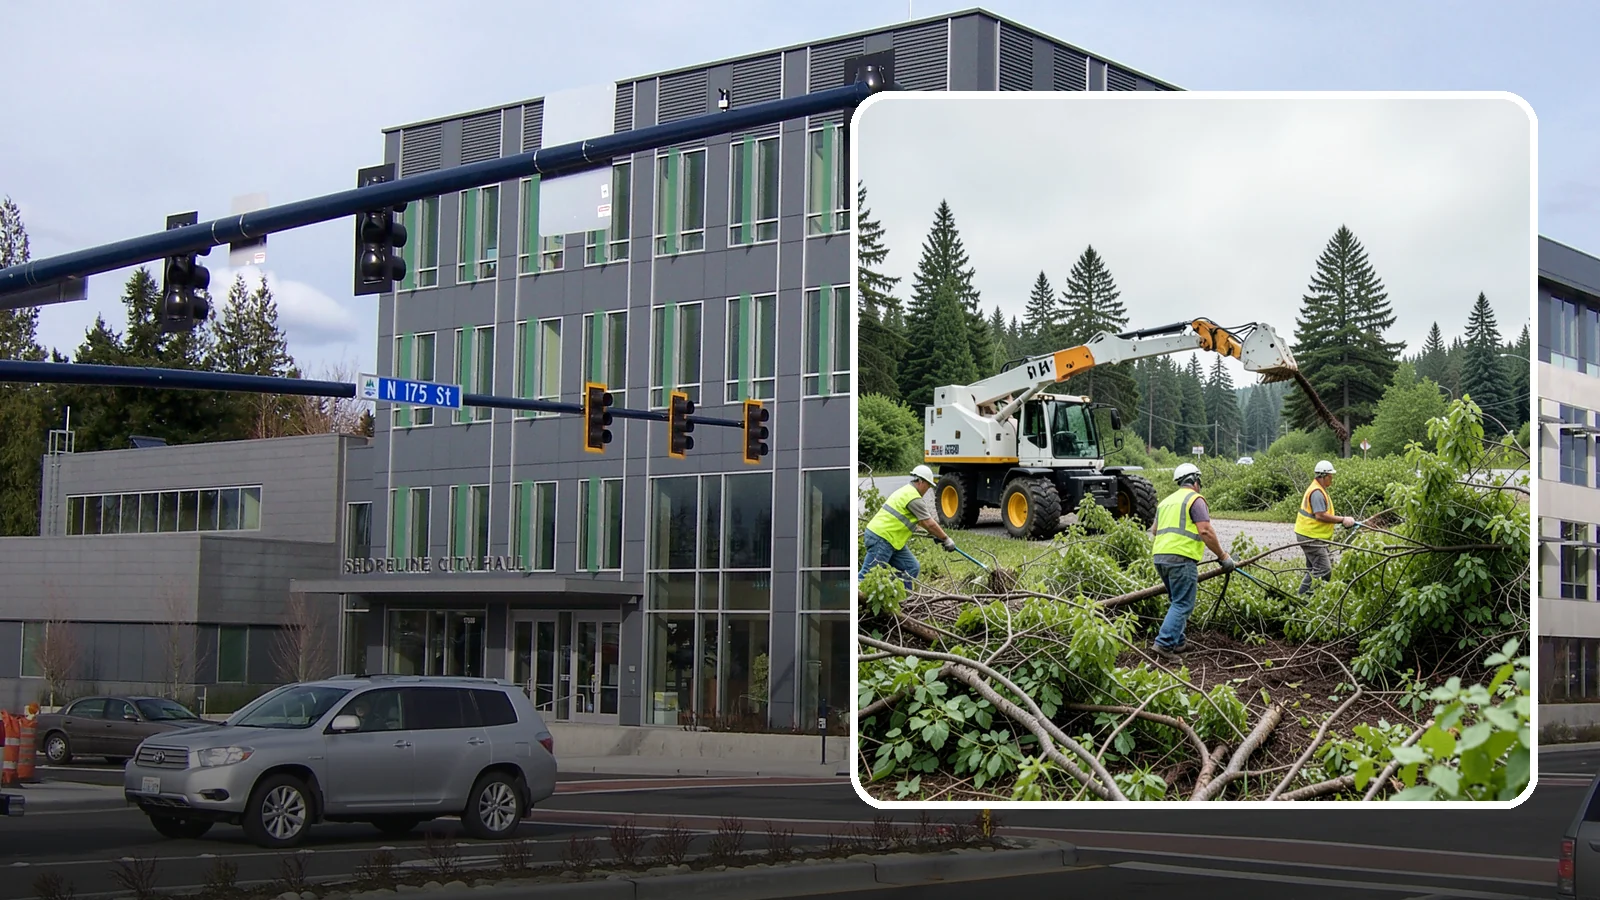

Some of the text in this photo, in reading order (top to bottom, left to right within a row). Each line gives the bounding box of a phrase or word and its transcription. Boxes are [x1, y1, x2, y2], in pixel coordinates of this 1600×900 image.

[387, 381, 451, 406] N 175 St
[344, 555, 526, 574] SHORELINE CITY HALL
